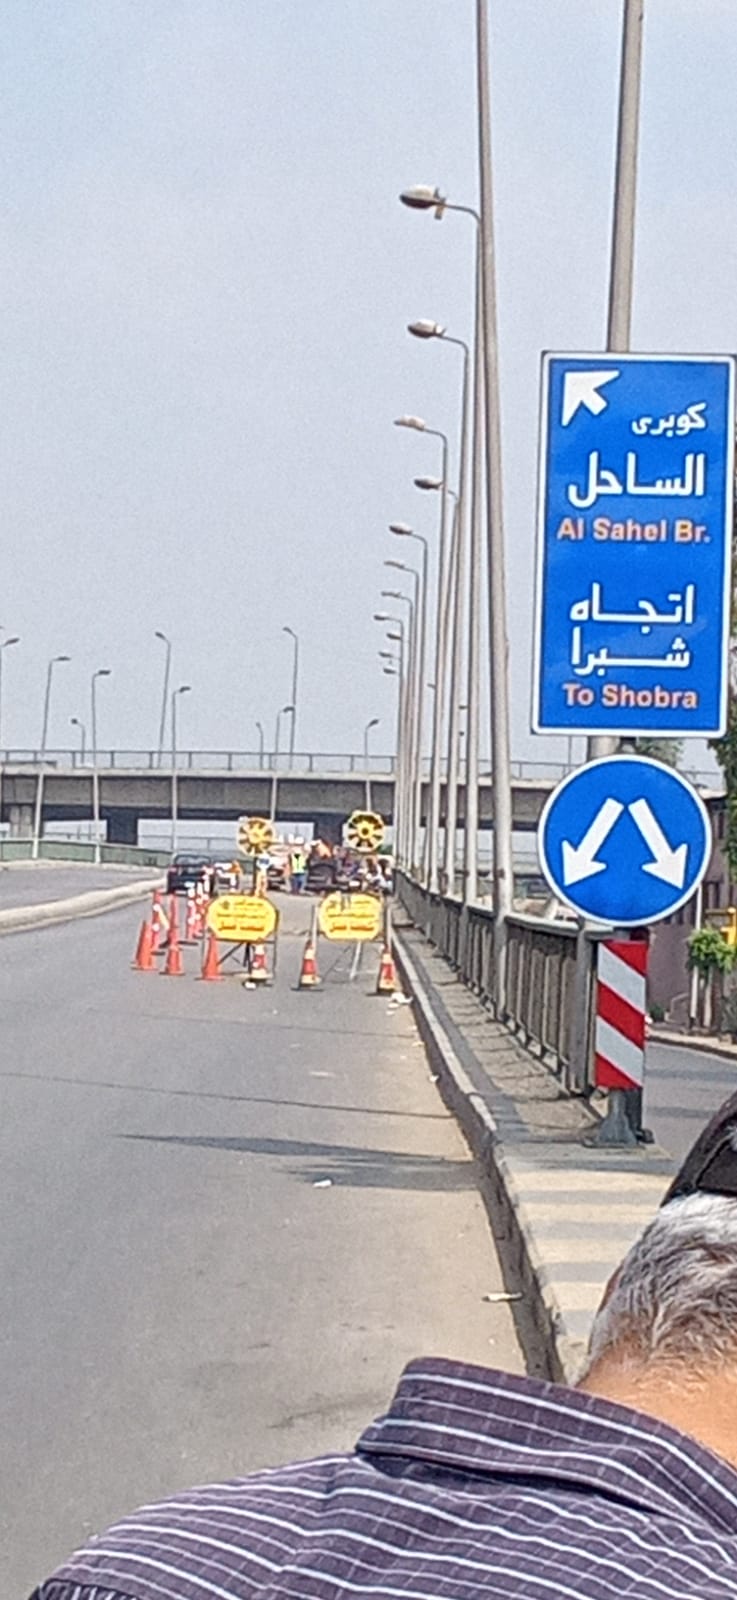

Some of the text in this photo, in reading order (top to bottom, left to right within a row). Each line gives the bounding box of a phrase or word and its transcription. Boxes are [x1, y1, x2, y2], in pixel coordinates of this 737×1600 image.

[567, 451, 705, 508] الساحل
[556, 517, 711, 543] Al Sahel Br.
[569, 582, 694, 634] اتجاه
[571, 626, 690, 676] شبرا
[562, 683, 698, 709] To Shobra
